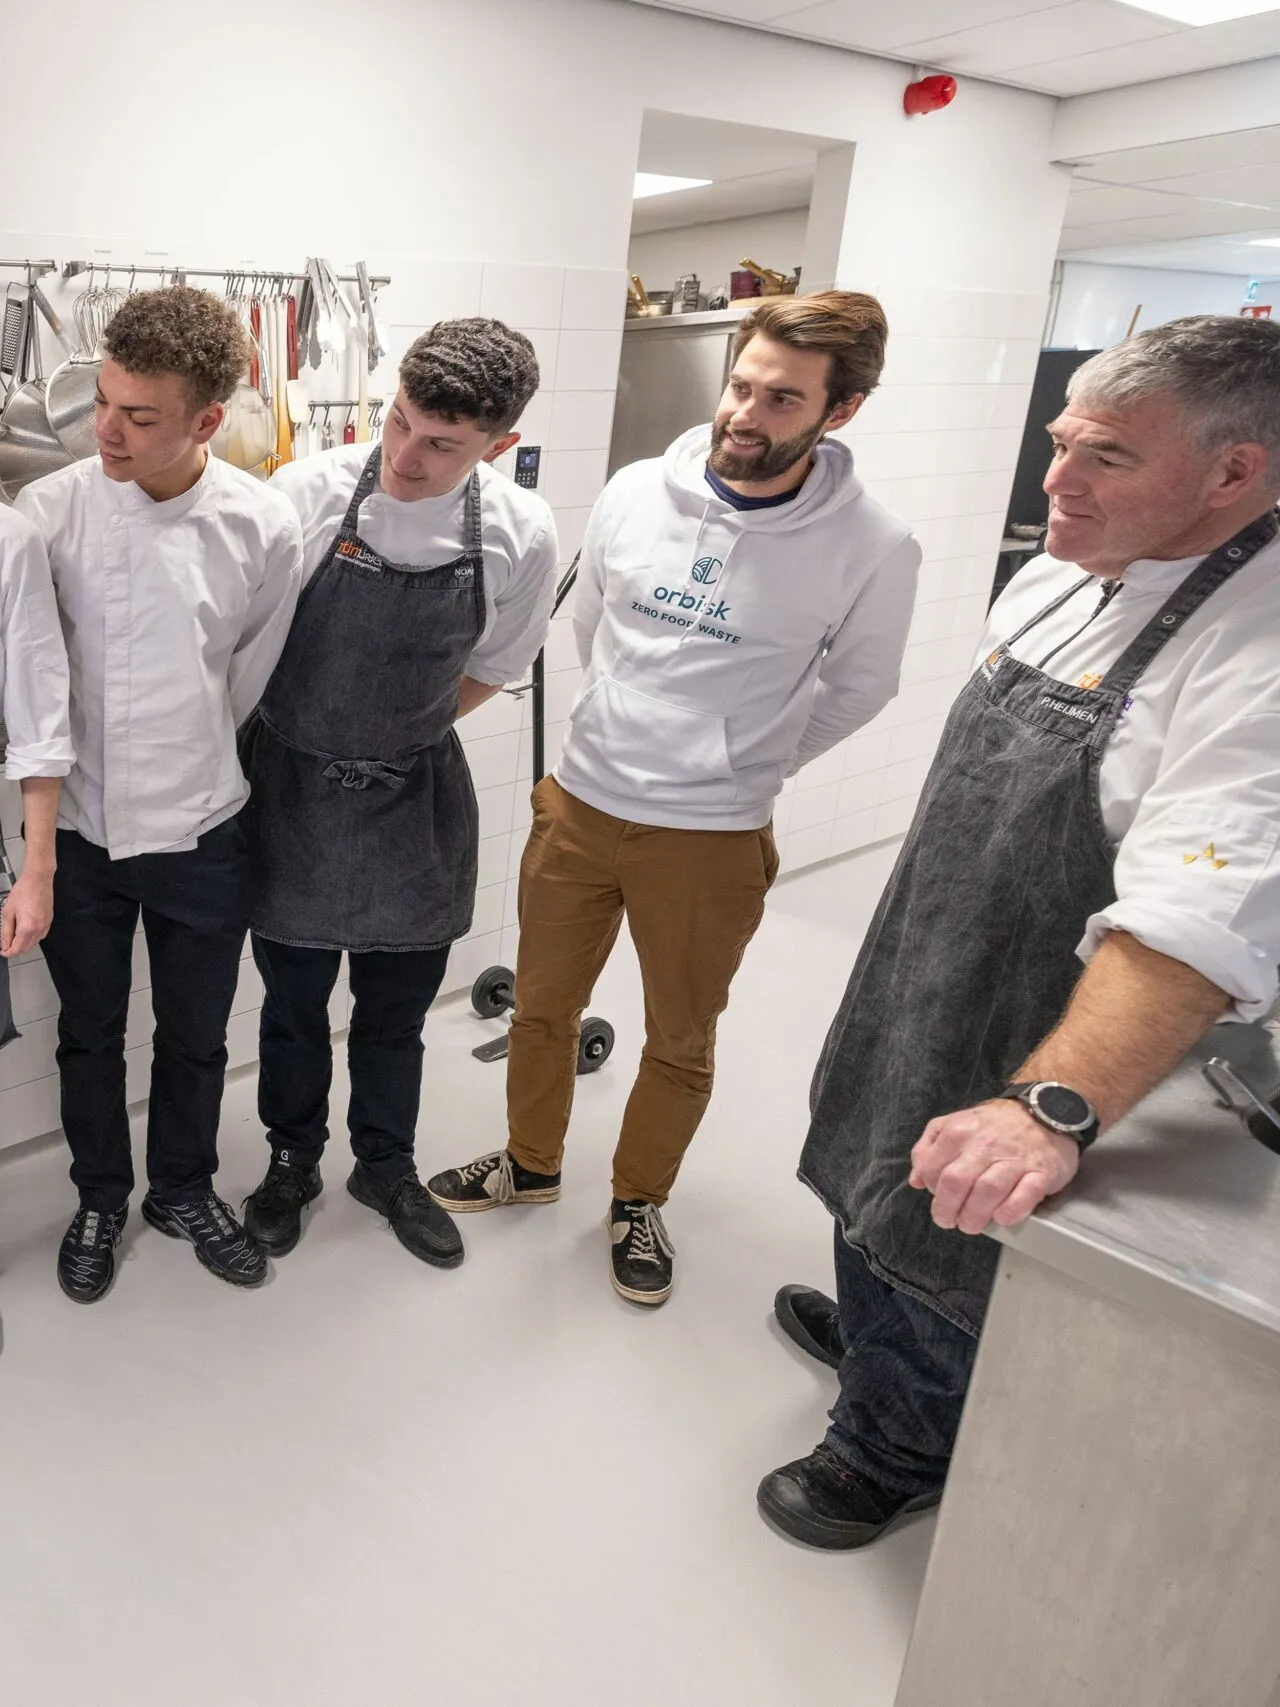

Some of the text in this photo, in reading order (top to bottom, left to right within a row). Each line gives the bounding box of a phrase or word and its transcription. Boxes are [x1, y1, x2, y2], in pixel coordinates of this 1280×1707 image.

[653, 586, 732, 621] orbisk
[631, 601, 658, 619] ZERO
[698, 623, 741, 644] WASTE
[280, 1150, 289, 1161] G
